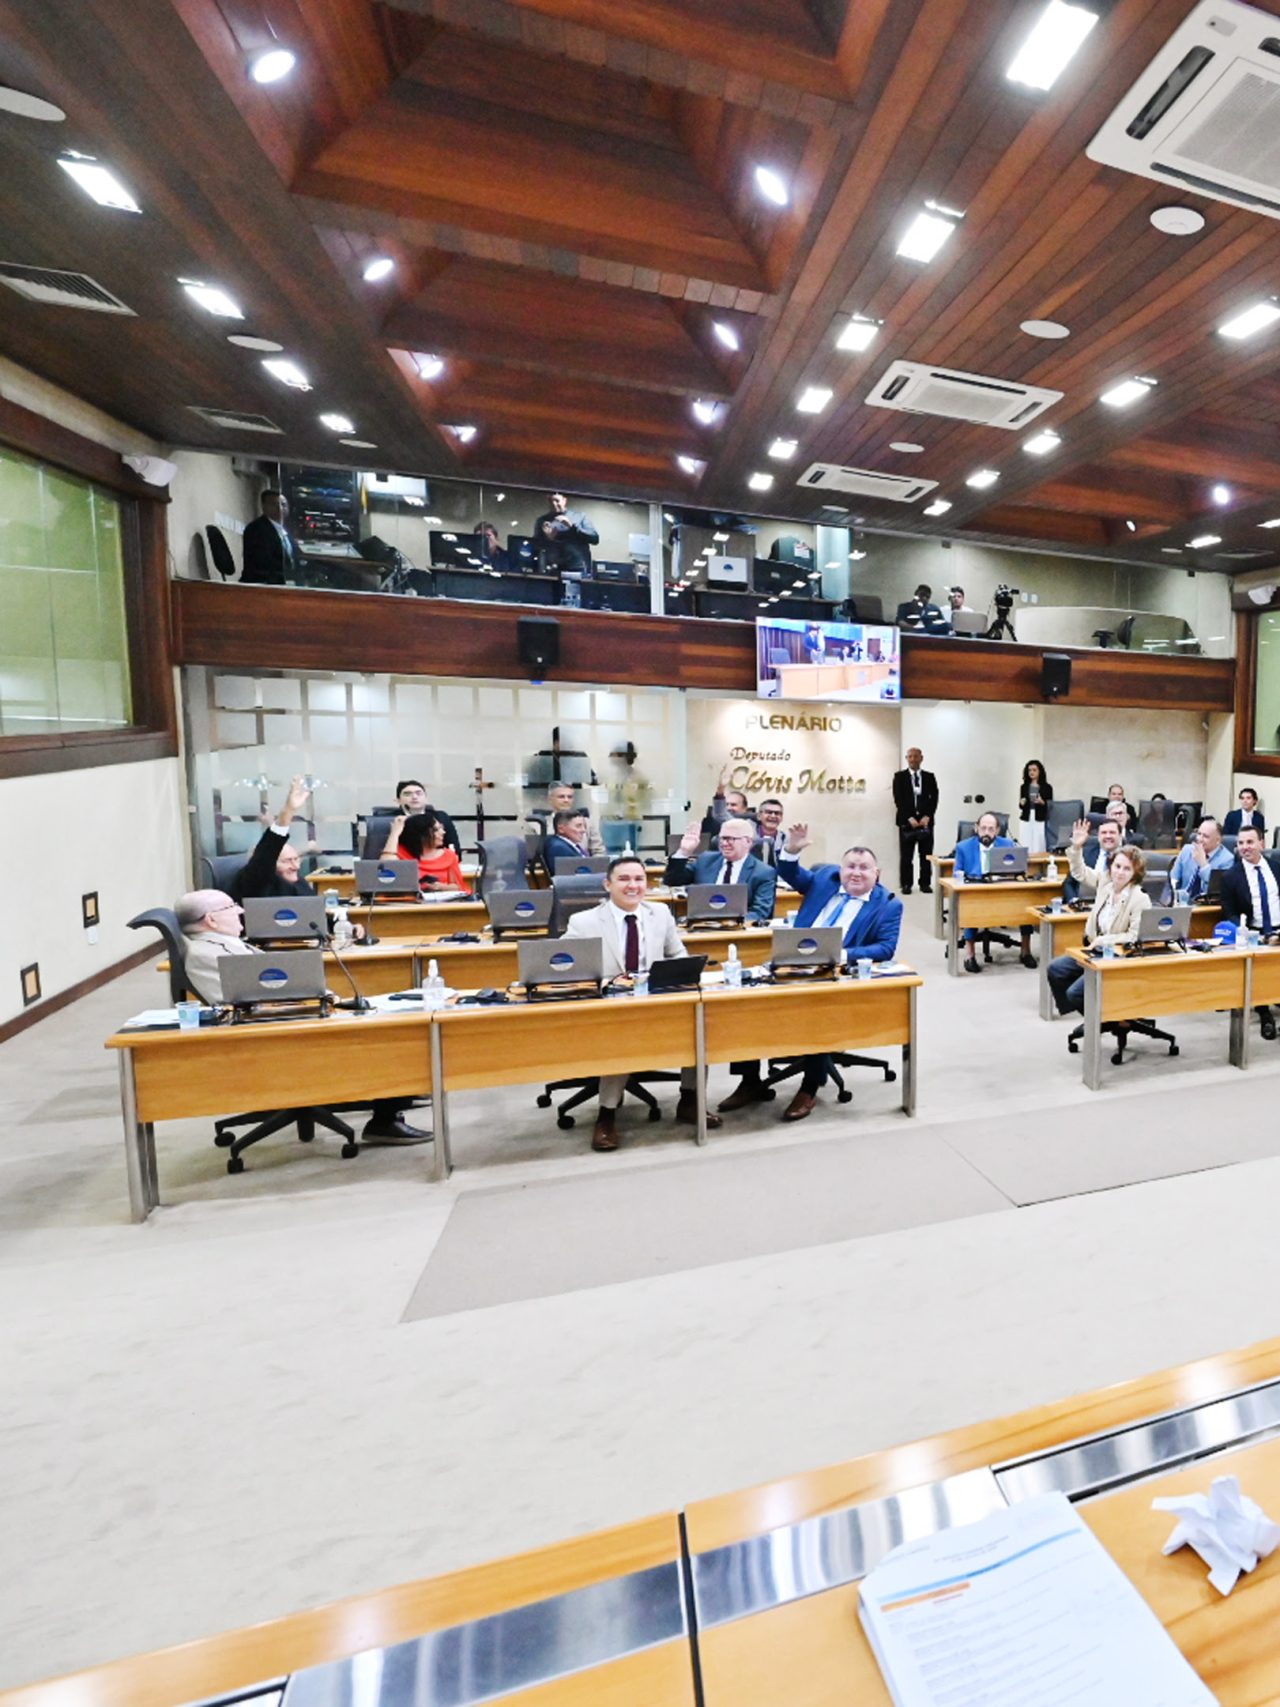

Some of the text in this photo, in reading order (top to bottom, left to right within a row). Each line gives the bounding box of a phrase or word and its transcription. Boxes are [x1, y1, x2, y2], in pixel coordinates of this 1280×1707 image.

[745, 711, 842, 732] PLENÁRIO
[730, 747, 791, 762] Deputado
[729, 765, 867, 794] Clóvis Motta
